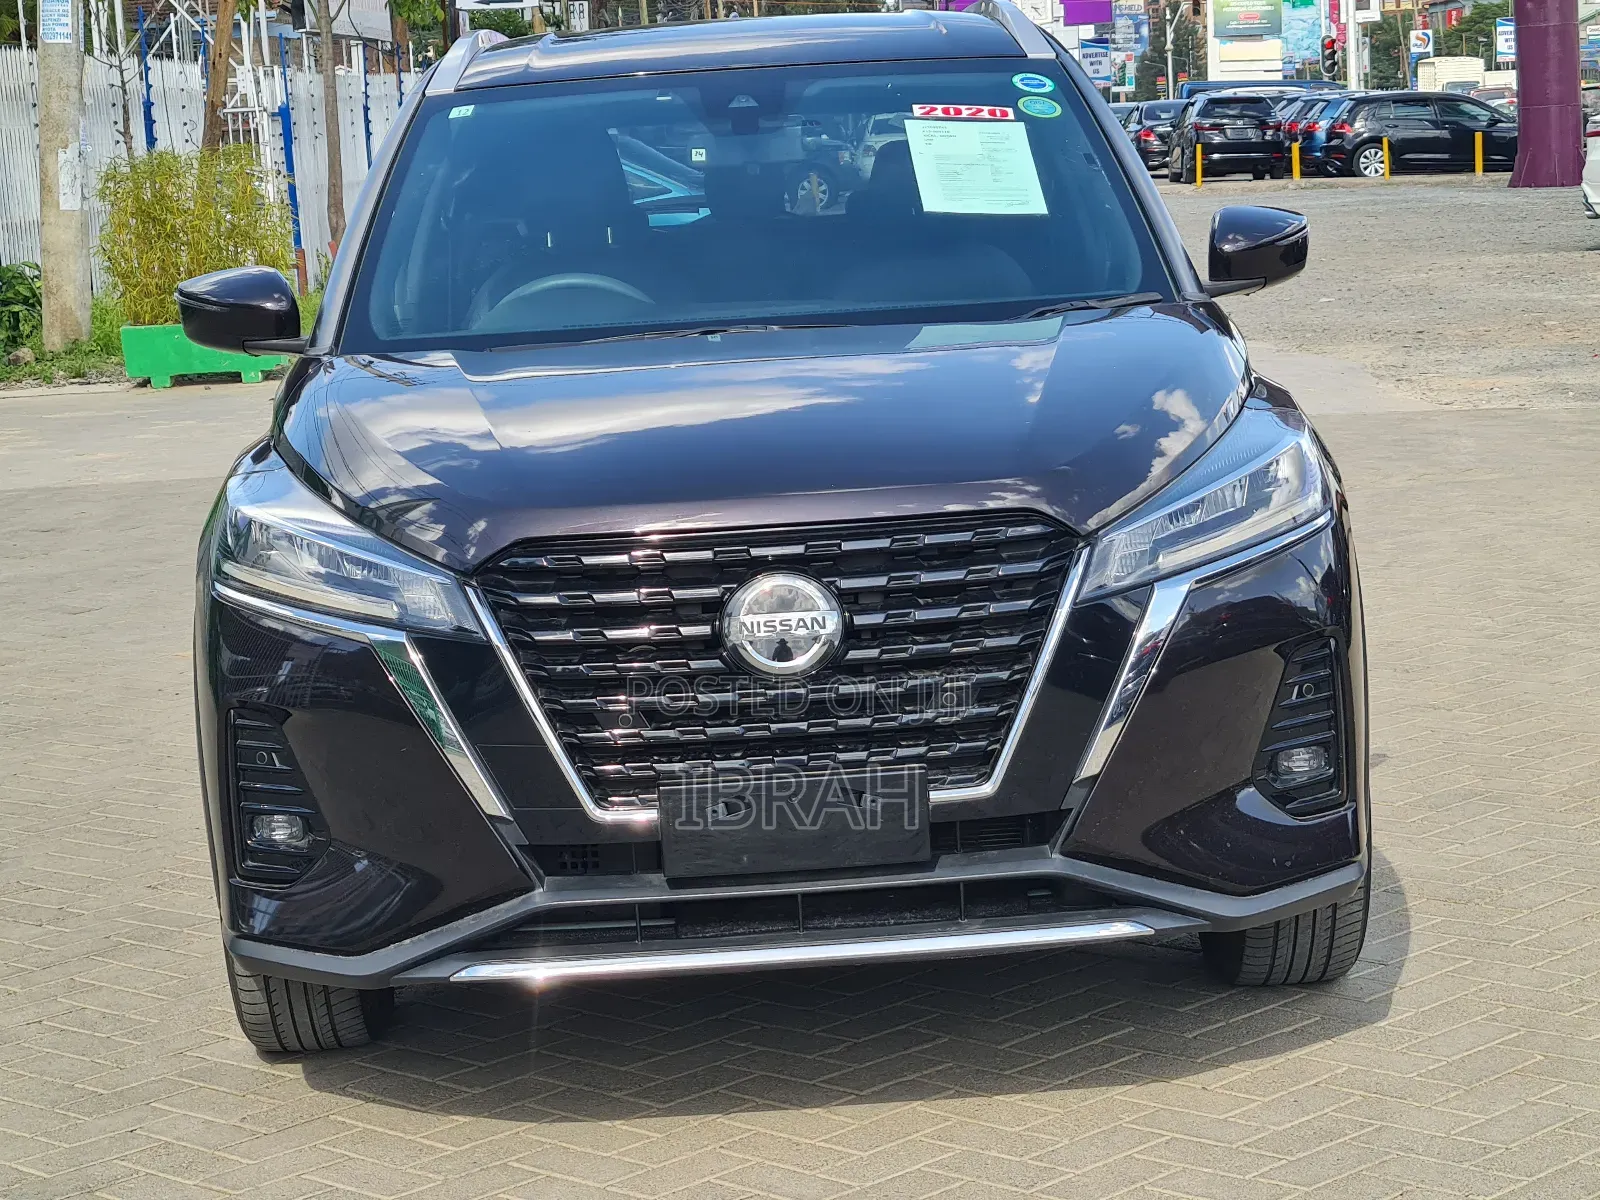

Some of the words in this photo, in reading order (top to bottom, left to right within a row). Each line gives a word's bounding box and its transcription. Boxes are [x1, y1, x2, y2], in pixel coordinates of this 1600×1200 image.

[1081, 51, 1109, 60] ADVERTISE
[918, 105, 1009, 118] 2020
[740, 615, 827, 635] NISSAN
